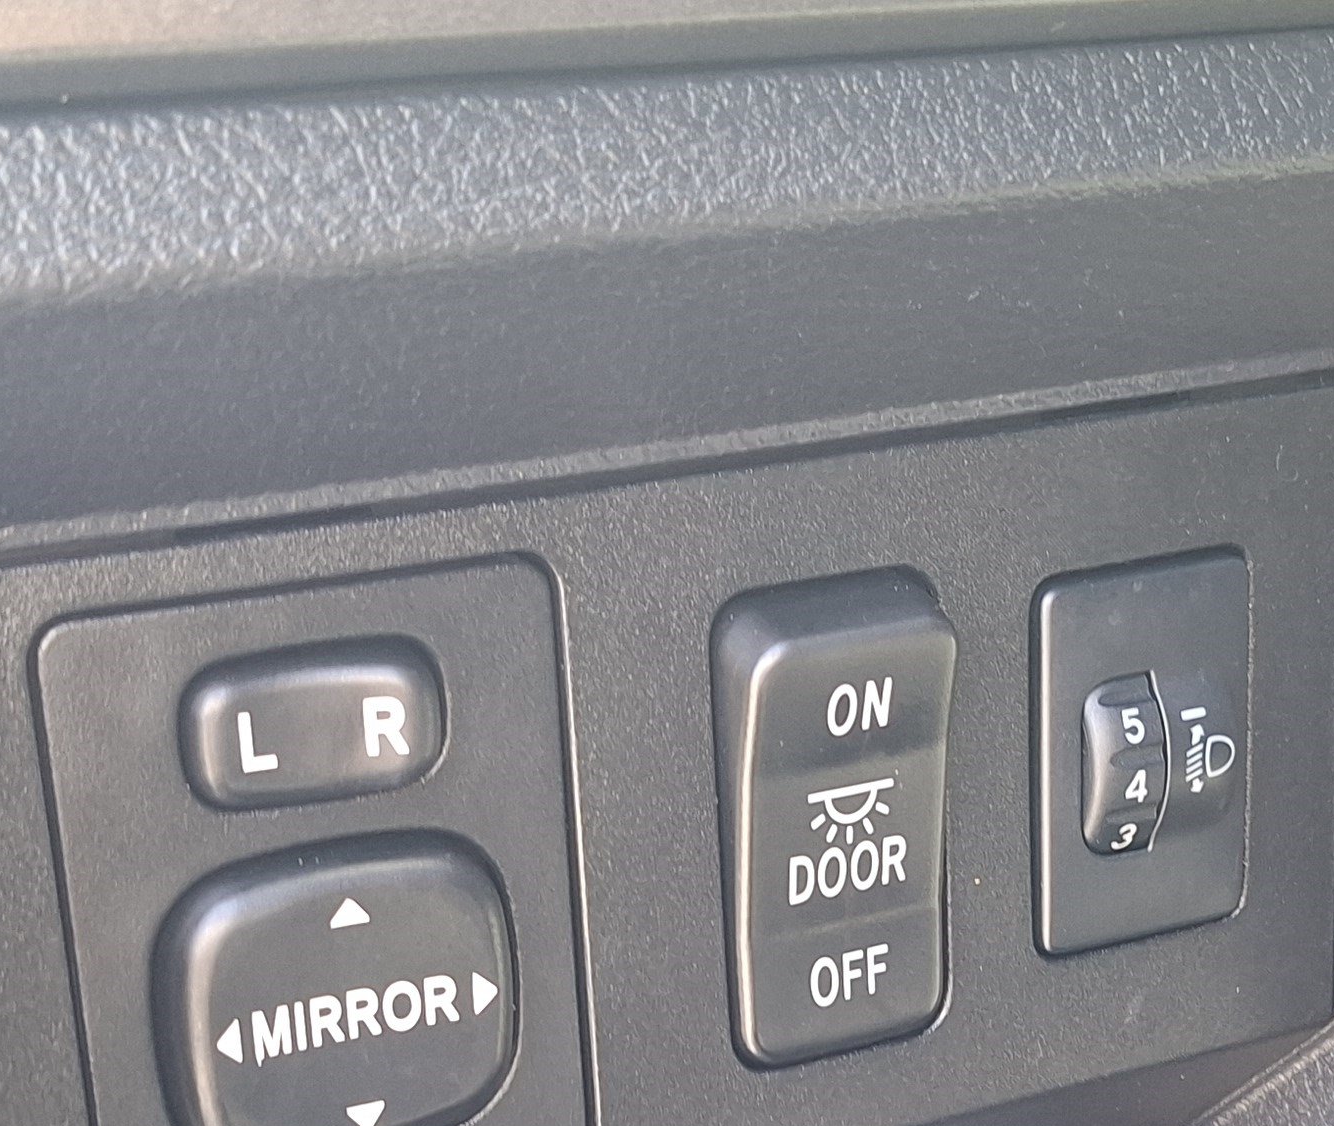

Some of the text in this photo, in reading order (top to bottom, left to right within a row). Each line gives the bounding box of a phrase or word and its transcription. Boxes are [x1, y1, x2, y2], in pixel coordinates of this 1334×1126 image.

[236, 695, 410, 774] L R
[826, 676, 894, 737] ON
[1120, 707, 1146, 745] 5
[1124, 769, 1149, 804] 4
[1109, 823, 1138, 851] 3
[787, 834, 908, 907] DOOR
[809, 943, 890, 1008] OFF
[250, 974, 461, 1068] MIRROR
